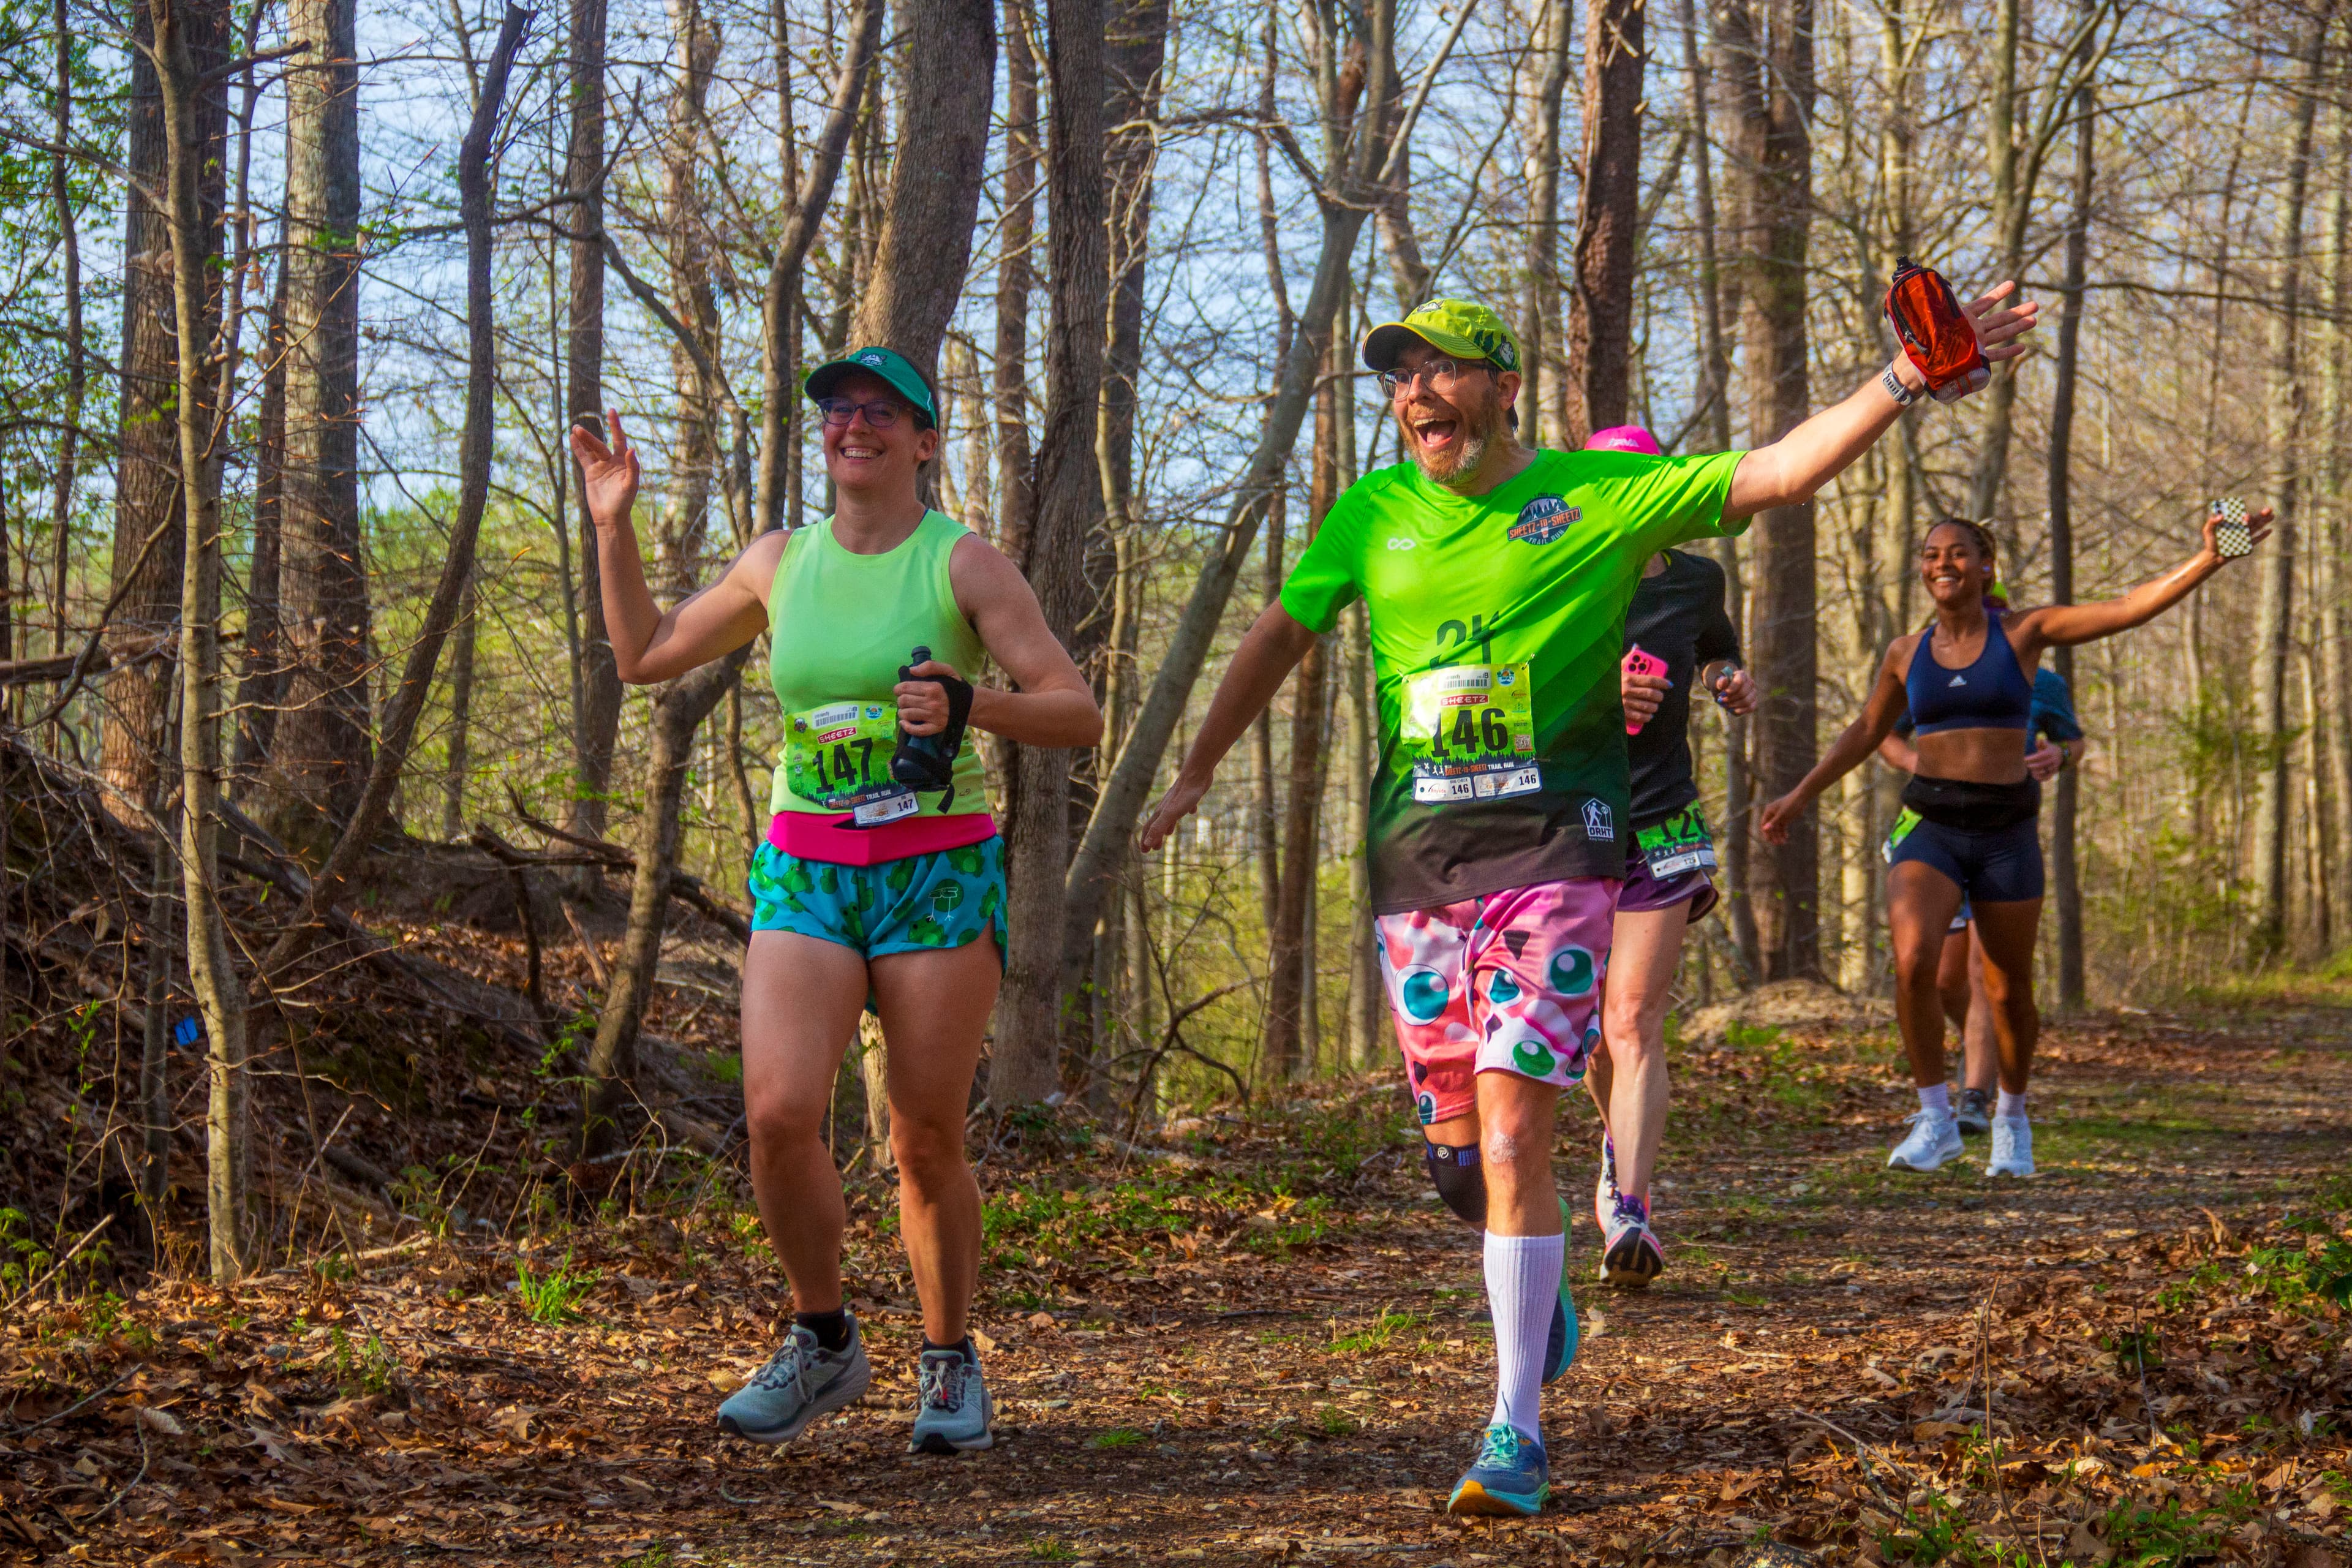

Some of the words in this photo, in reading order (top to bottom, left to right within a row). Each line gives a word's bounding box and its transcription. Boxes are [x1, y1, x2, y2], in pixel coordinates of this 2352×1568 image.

[1528, 537, 1549, 545] TRAIL
[1551, 529, 1566, 541] RUN
[1441, 695, 1486, 706] SHEETZ
[819, 728, 855, 743] SHEETZ
[1431, 707, 1508, 758] 146
[812, 737, 873, 794] 147
[1519, 774, 1537, 785] 146
[1451, 783, 1469, 795] 146
[897, 798, 913, 812] 147
